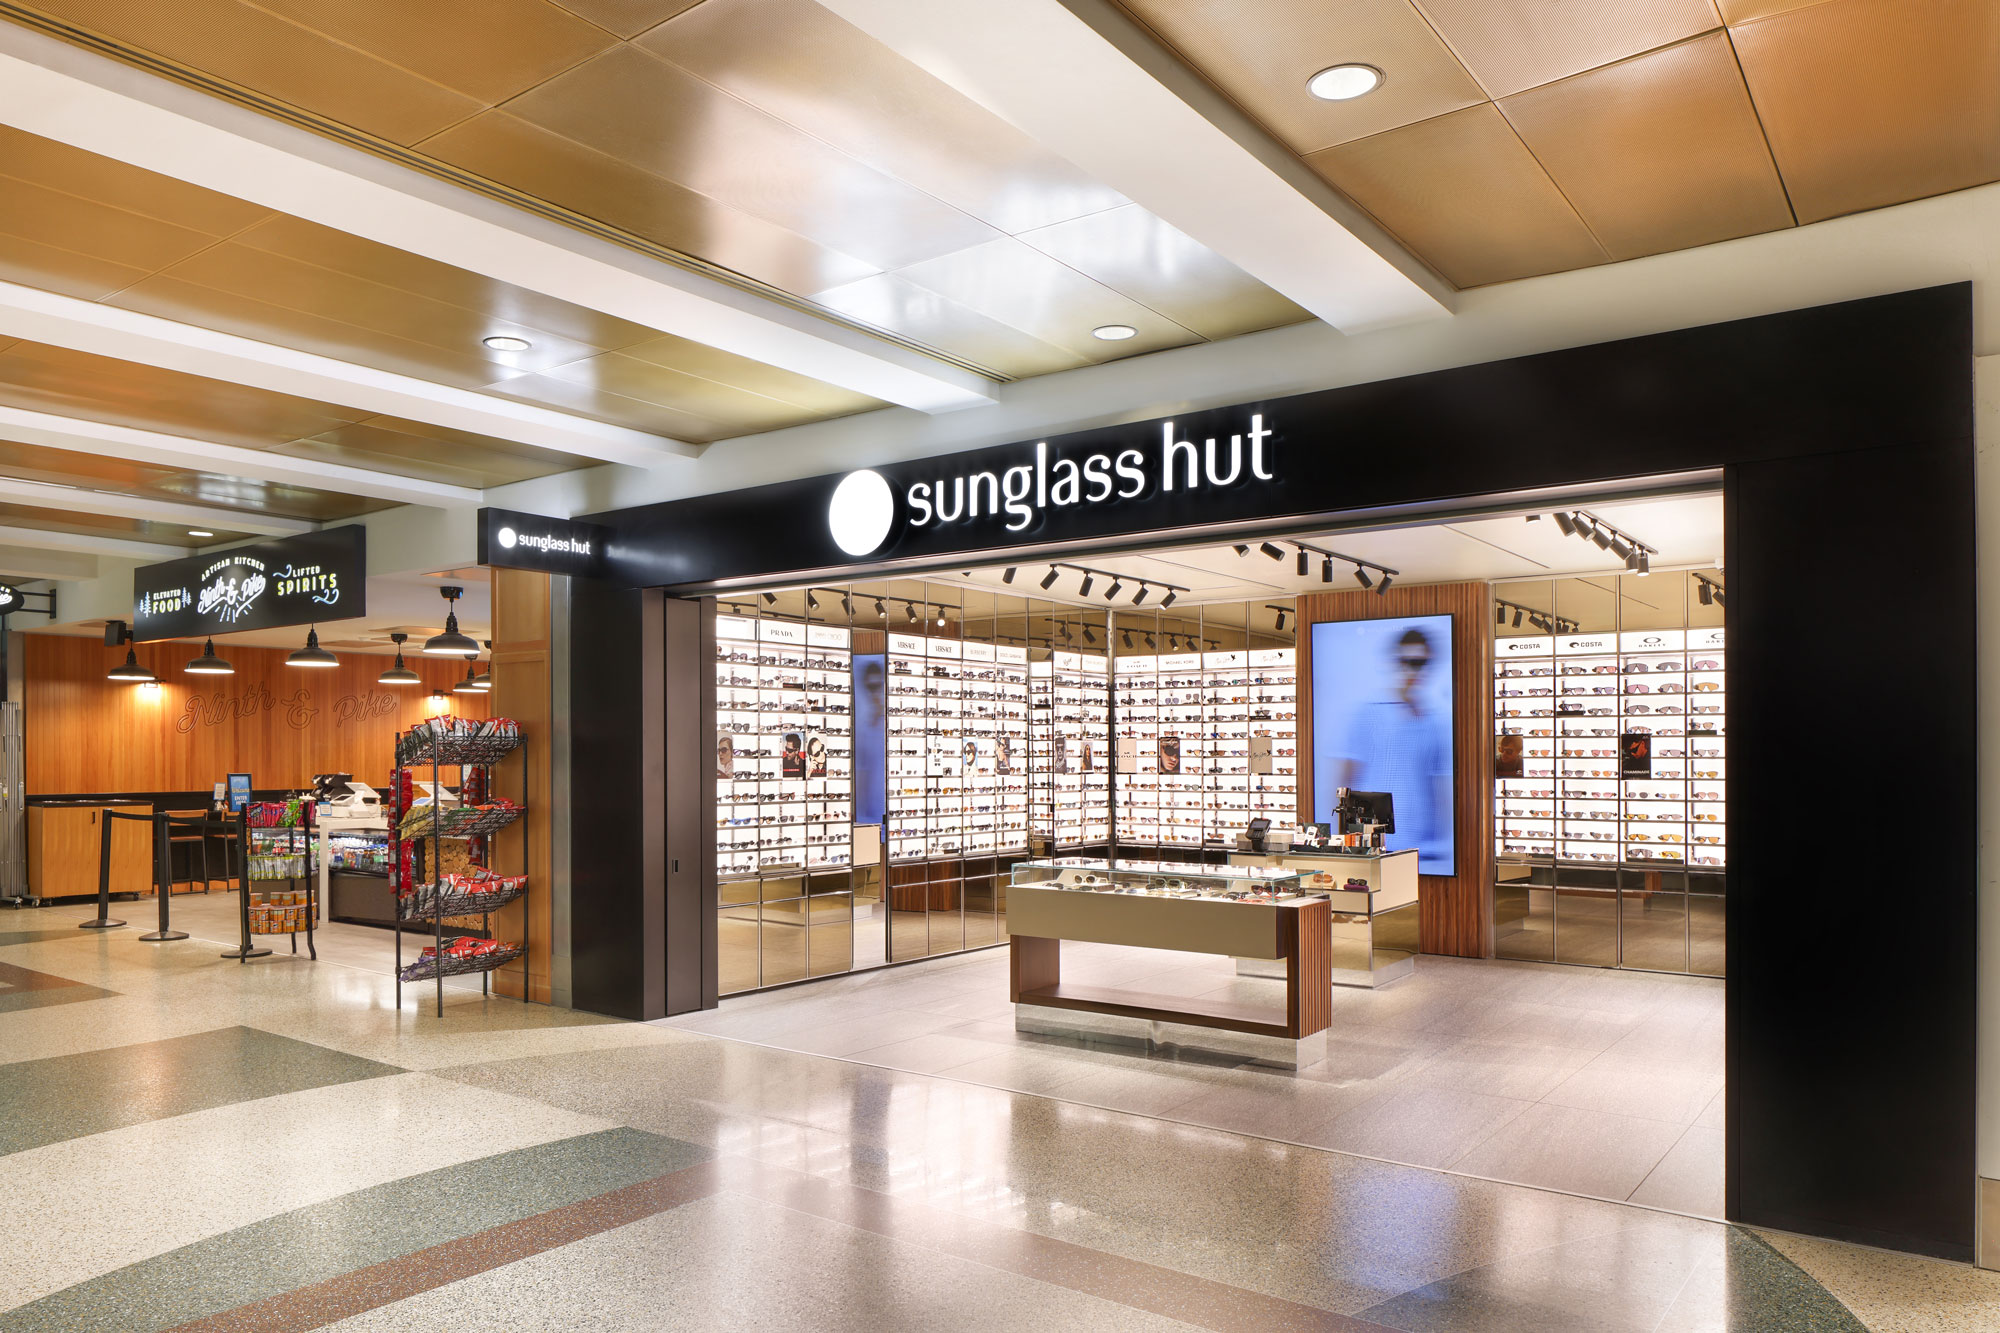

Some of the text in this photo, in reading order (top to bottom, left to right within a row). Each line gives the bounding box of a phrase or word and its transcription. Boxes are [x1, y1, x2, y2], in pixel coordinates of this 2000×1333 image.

[907, 414, 1272, 531] sunglass hut
[519, 534, 591, 555] sunglass hut
[202, 556, 265, 581] ARTISAN KITCHEN
[293, 565, 321, 578] LIFTED
[197, 572, 267, 613] Ninth & Pike
[277, 573, 337, 597] SPIRITS
[153, 589, 181, 600] ELEVATED
[152, 598, 181, 614] FOOD
[770, 629, 793, 638] PRADA
[897, 641, 915, 649] VERSACE
[935, 645, 952, 653] VERSACE
[176, 681, 398, 734] Ninth & Pike
